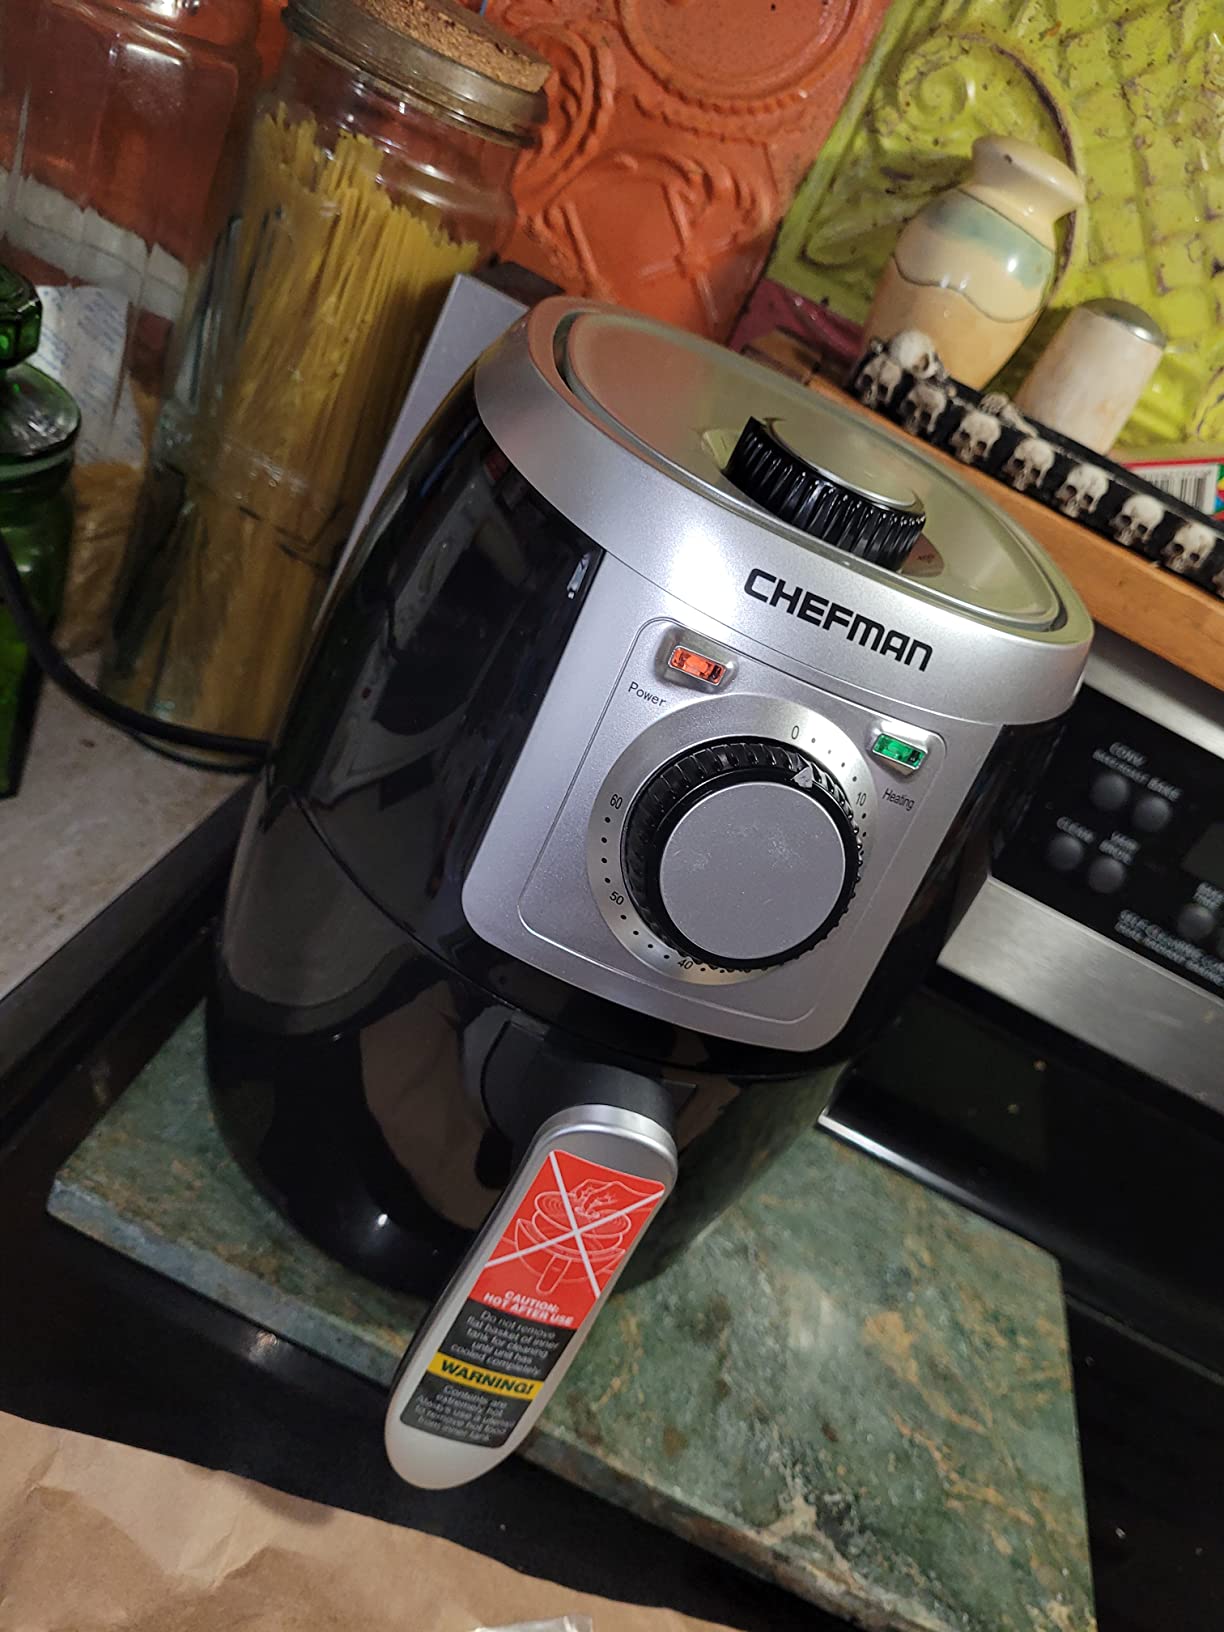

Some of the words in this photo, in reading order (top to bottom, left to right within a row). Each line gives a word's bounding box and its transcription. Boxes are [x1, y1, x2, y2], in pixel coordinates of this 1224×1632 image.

[744, 568, 933, 672] CHEFMAN
[628, 681, 666, 706] Power
[790, 725, 800, 740] 0
[610, 794, 623, 809] 60
[856, 792, 867, 806] 10
[882, 788, 915, 811] Heating
[610, 891, 624, 905] 50
[678, 959, 693, 969] 40
[483, 1292, 509, 1308] HOT
[510, 1303, 550, 1321] AFTER
[549, 1313, 574, 1326] USE
[504, 1290, 560, 1313] CAUTION:
[480, 1310, 497, 1322] Do
[498, 1318, 517, 1329] not
[441, 1359, 534, 1395] WARNING!
